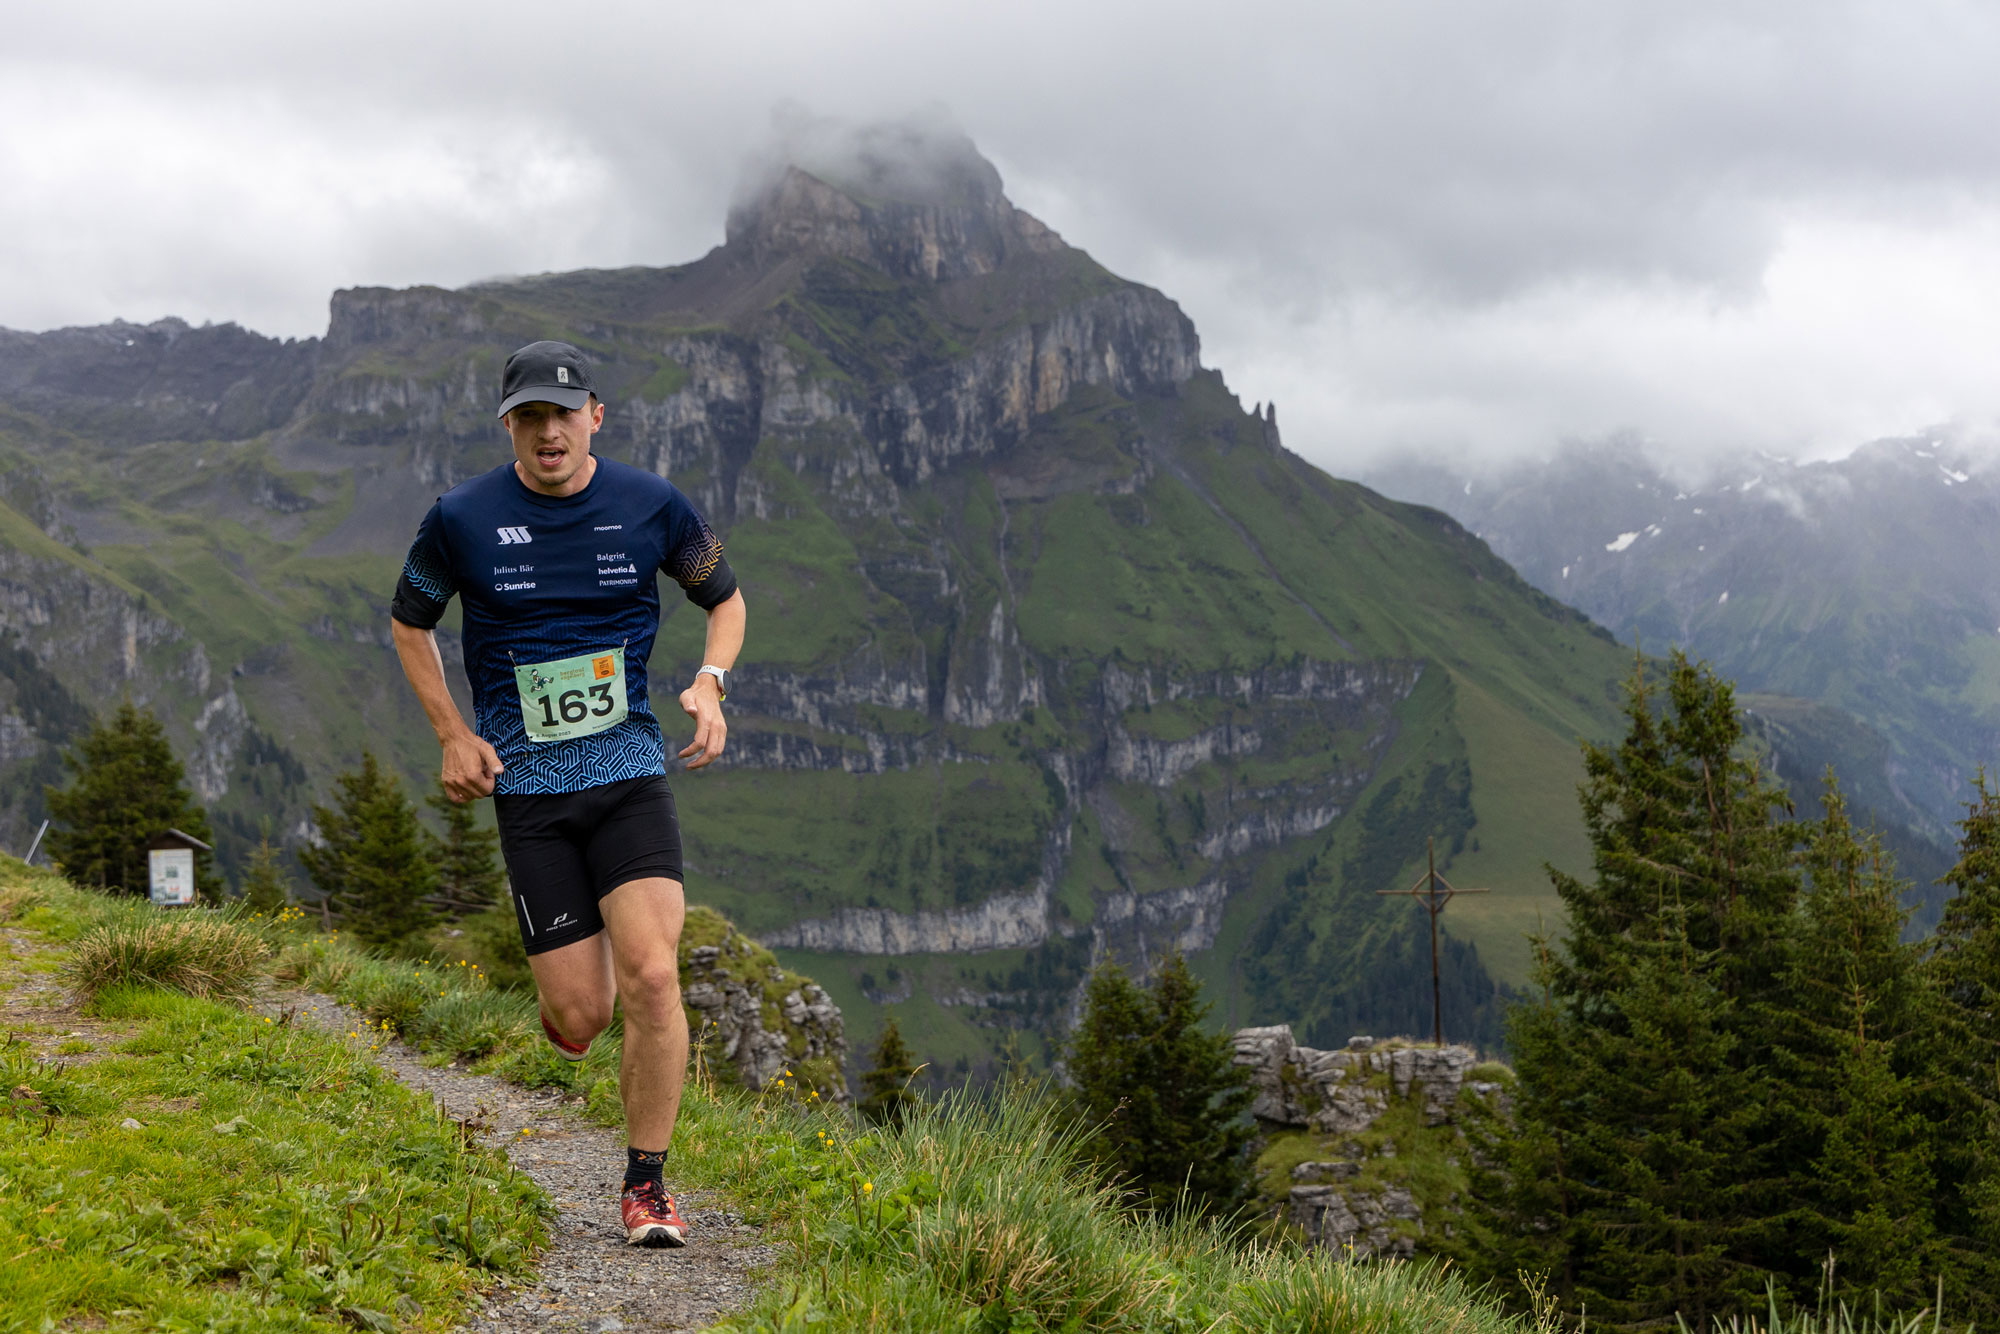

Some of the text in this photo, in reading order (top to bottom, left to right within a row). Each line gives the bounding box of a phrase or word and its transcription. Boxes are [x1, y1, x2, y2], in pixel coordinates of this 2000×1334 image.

[597, 552, 625, 562] Balgrist
[494, 564, 534, 576] Julius Bär
[598, 566, 628, 575] helvetia
[503, 581, 536, 591] Sunrise
[538, 682, 614, 727] 163
[559, 919, 578, 927] TOUCH
